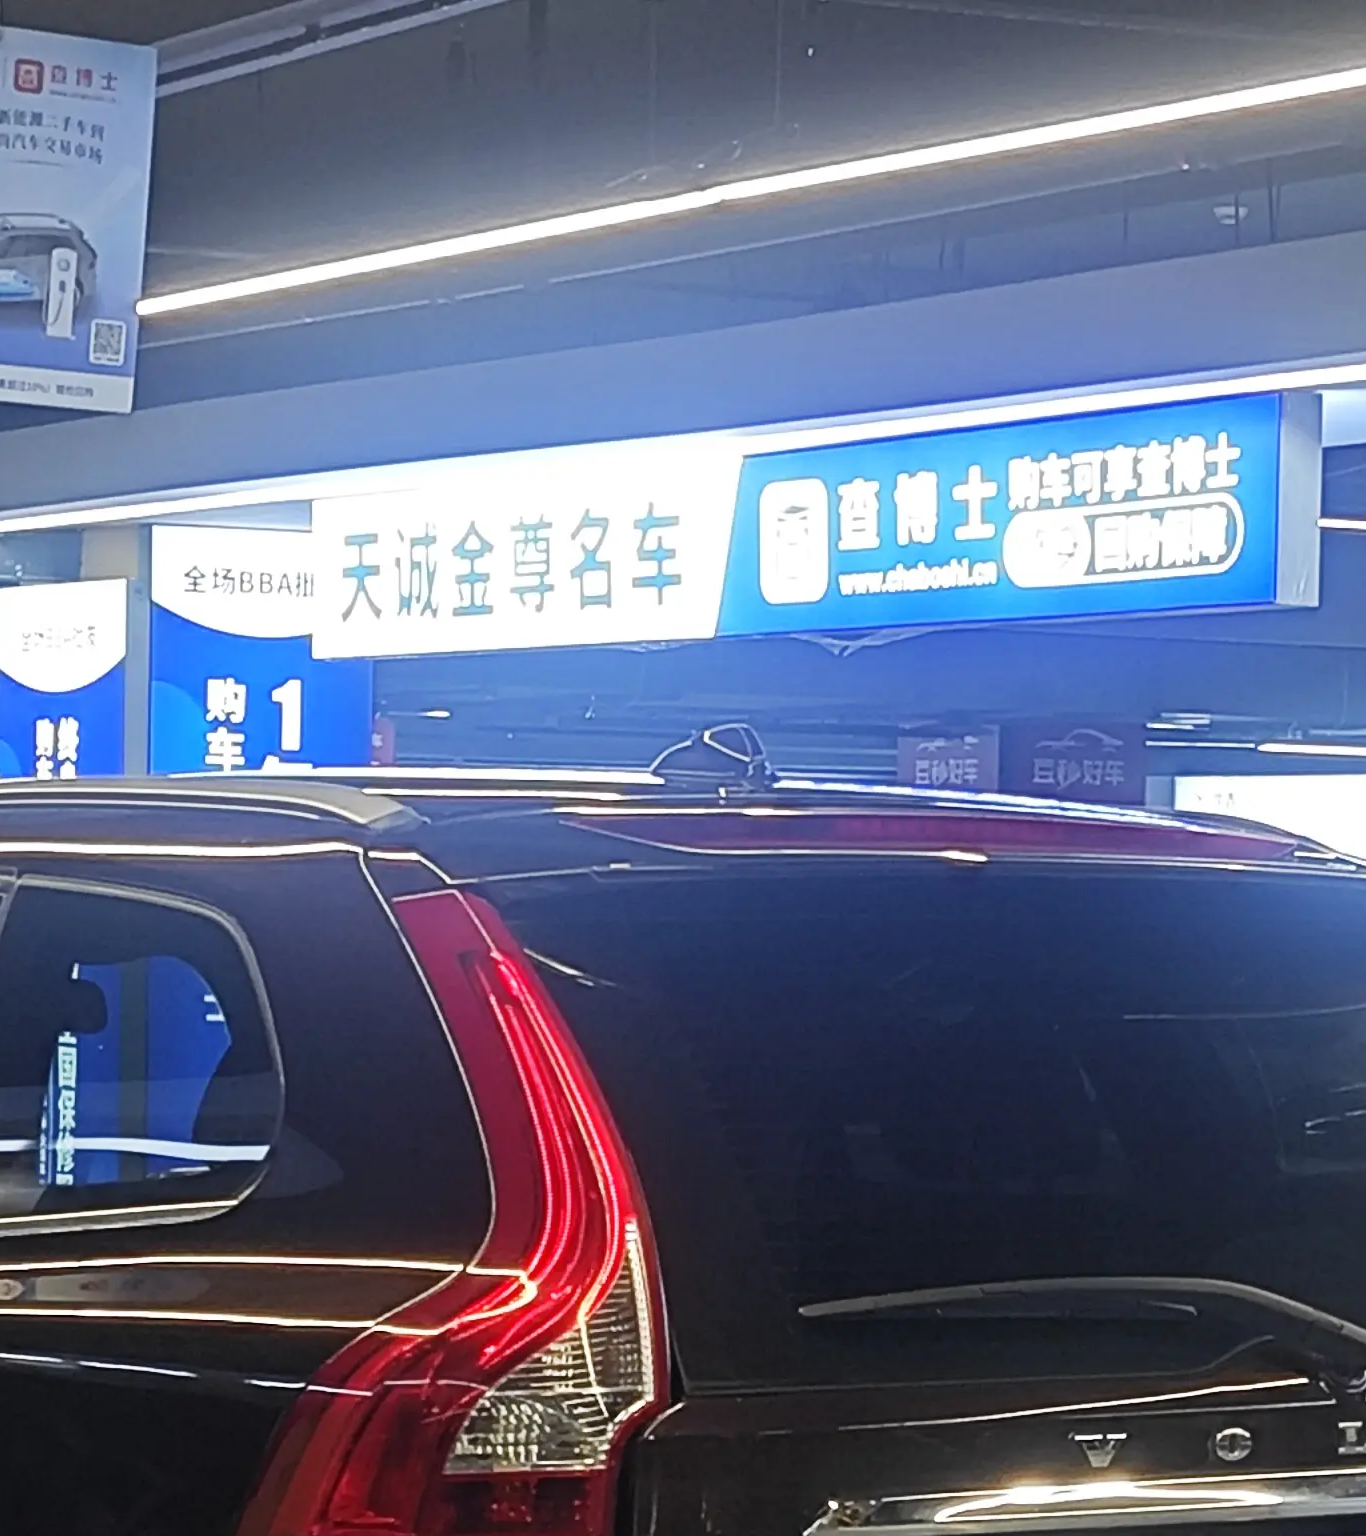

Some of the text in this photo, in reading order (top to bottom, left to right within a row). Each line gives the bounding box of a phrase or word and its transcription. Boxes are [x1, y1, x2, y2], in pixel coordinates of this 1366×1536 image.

[837, 464, 999, 552] 查博士
[1007, 437, 1241, 512] 购车可享查博士
[341, 502, 682, 622] 天诚金尊名车
